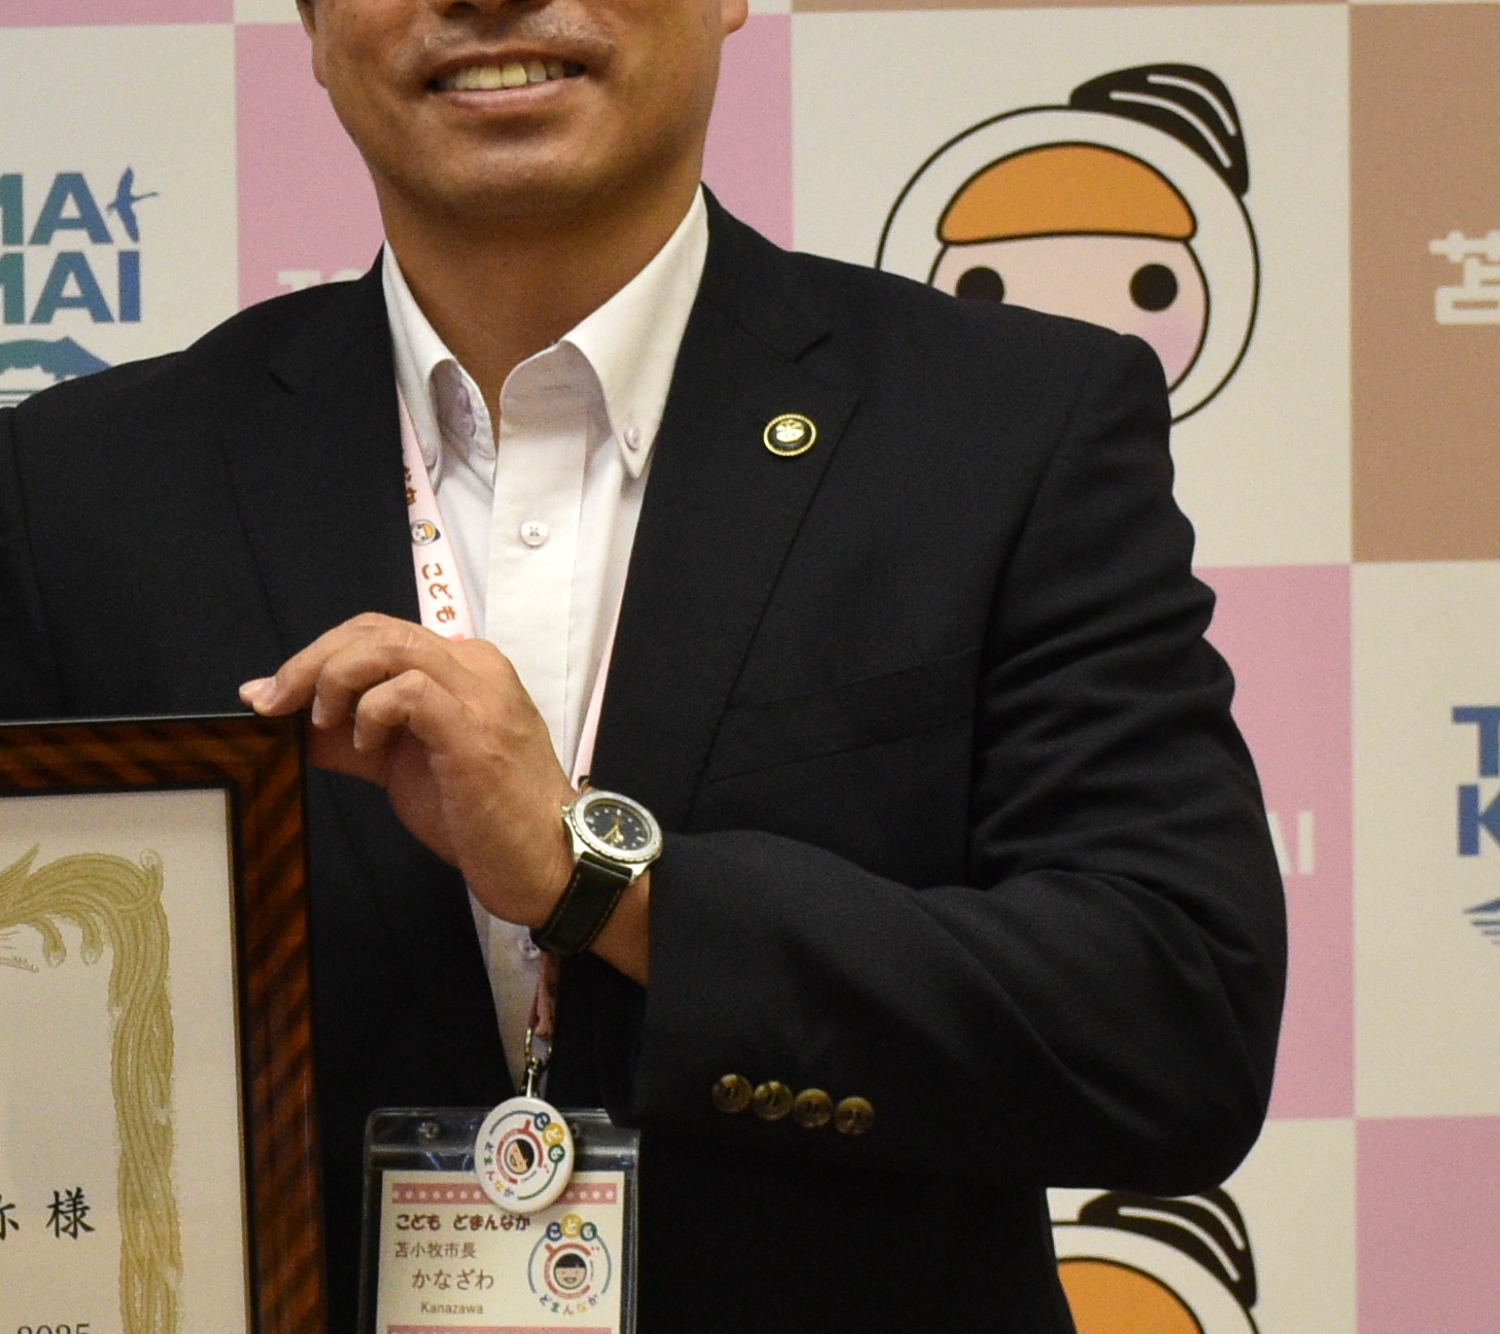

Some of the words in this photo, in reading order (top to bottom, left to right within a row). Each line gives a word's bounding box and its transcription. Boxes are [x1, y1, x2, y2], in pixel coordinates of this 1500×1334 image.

[395, 1214, 441, 1231] こども
[453, 1213, 531, 1231] どまんなか
[394, 1241, 477, 1259] 苫小牧市長
[411, 1269, 495, 1291] かなざわ
[420, 1301, 484, 1315] Kanazawa
